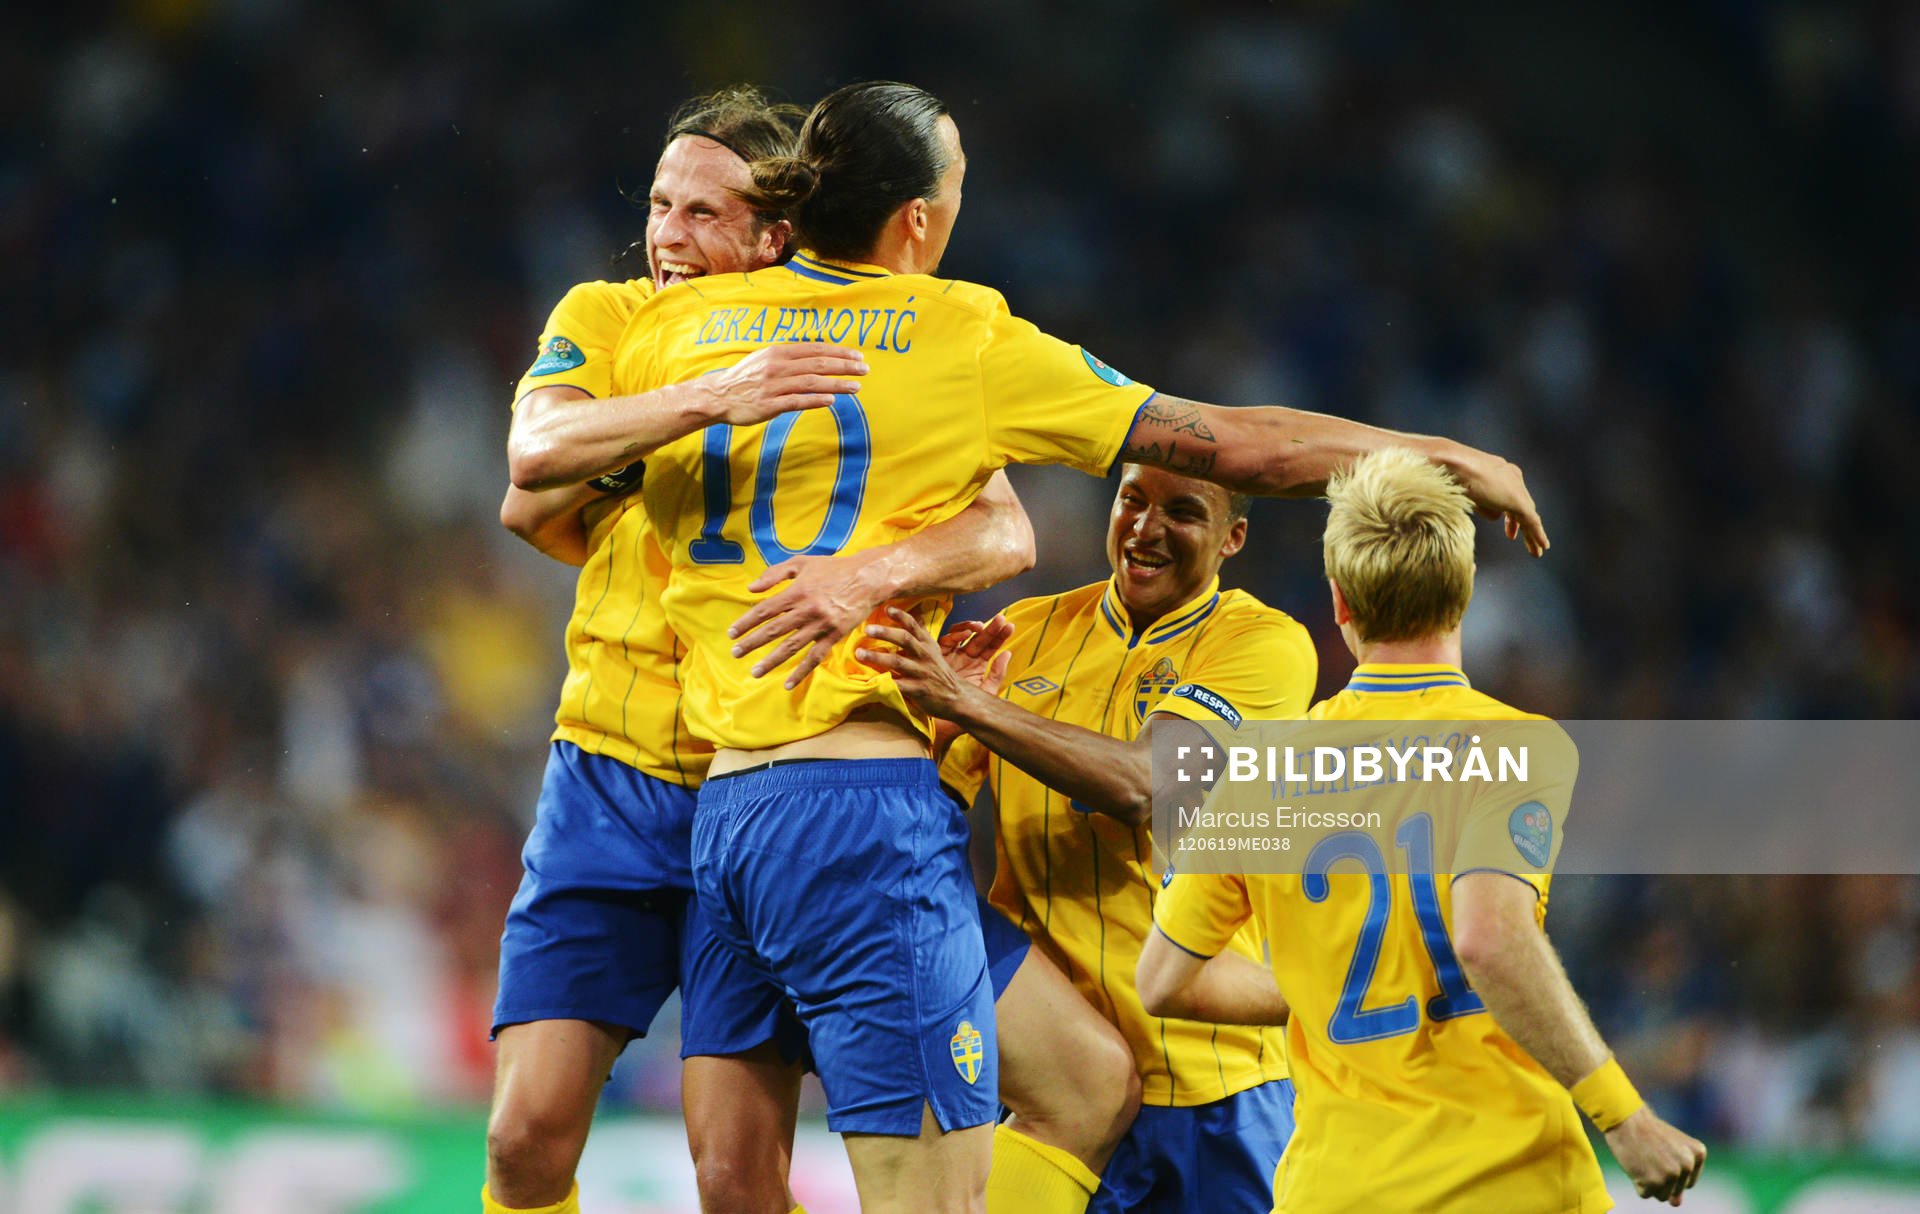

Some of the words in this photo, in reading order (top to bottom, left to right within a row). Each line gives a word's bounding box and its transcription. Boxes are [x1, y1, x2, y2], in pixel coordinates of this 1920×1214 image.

[695, 296, 916, 354] IBRAHIMOVIĆ
[688, 368, 872, 567] 10
[1193, 687, 1241, 726] RESPECT
[1302, 811, 1488, 1044] 21
